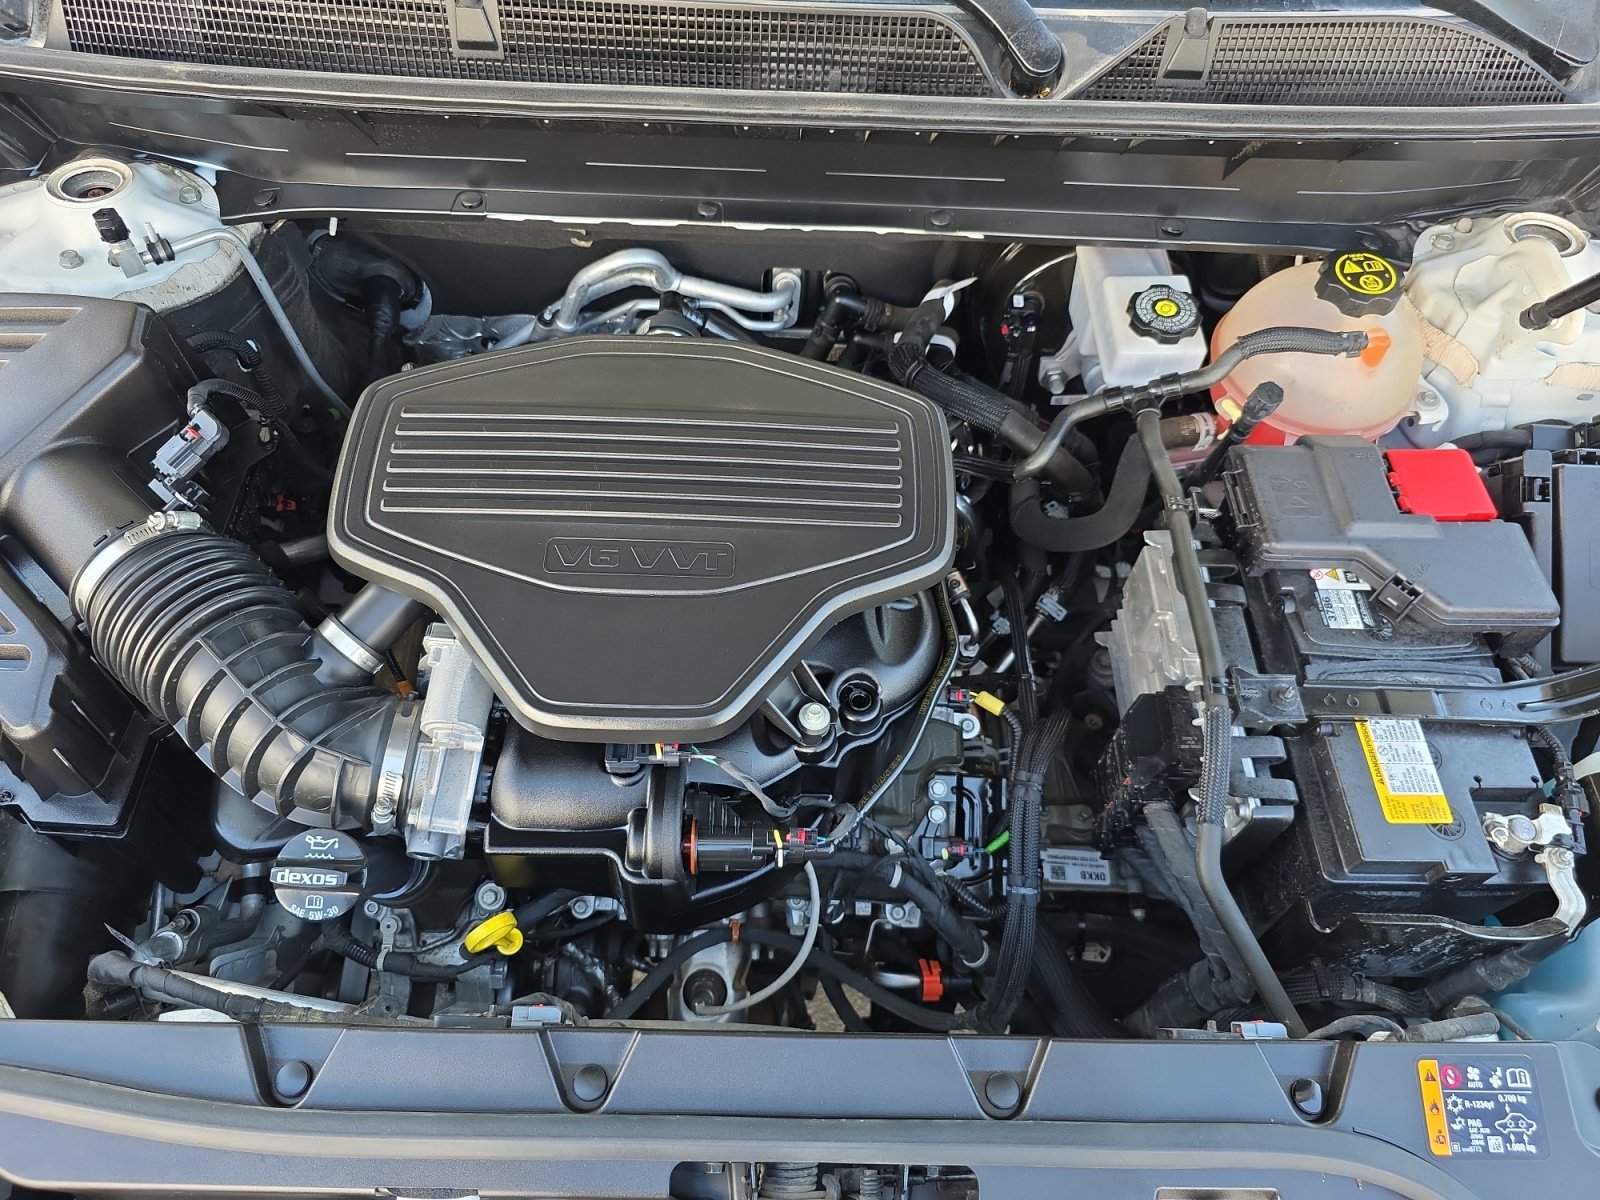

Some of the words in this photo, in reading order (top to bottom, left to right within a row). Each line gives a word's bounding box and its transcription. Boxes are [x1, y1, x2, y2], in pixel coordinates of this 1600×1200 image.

[554, 544, 619, 567] V6
[630, 545, 727, 571] VVT
[1322, 596, 1336, 621] 3786
[276, 868, 339, 886] dexos
[291, 904, 306, 918] SAE
[308, 905, 339, 920] 5W-30
[1464, 1100, 1495, 1110] R-1234yf
[1498, 1094, 1517, 1103] 0.700
[1516, 1094, 1527, 1105] kg
[1467, 1118, 1482, 1128] PAG
[1506, 1143, 1525, 1152] 1.000
[1525, 1143, 1536, 1153] kg
